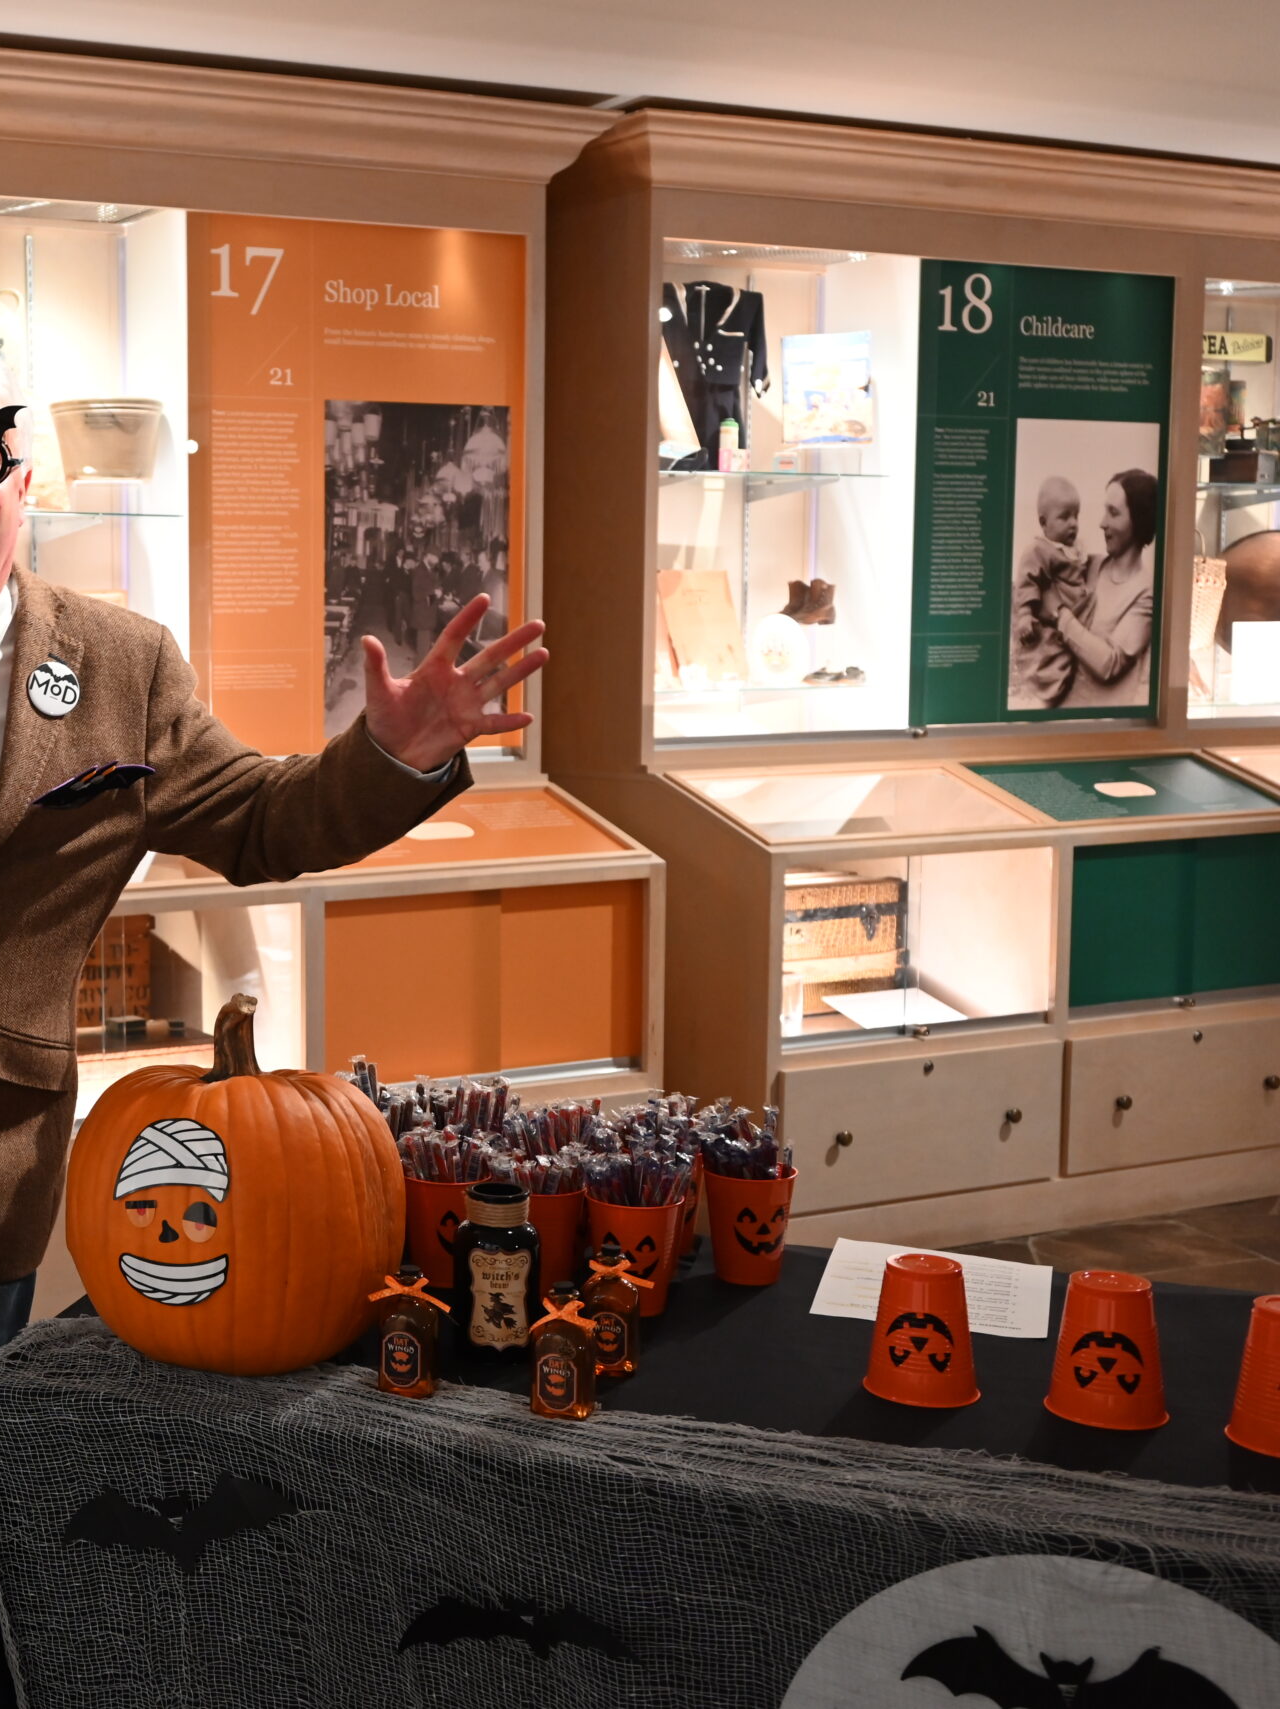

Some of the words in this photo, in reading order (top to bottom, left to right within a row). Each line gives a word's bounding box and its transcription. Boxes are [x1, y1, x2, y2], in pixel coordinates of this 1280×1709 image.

[210, 243, 284, 315] 17
[324, 279, 379, 310] Shop
[385, 284, 440, 309] Local
[937, 273, 993, 334] 18
[1020, 315, 1095, 339] Childcare
[269, 368, 294, 386] 21
[977, 391, 995, 407] 21
[482, 1271, 519, 1280] witch's
